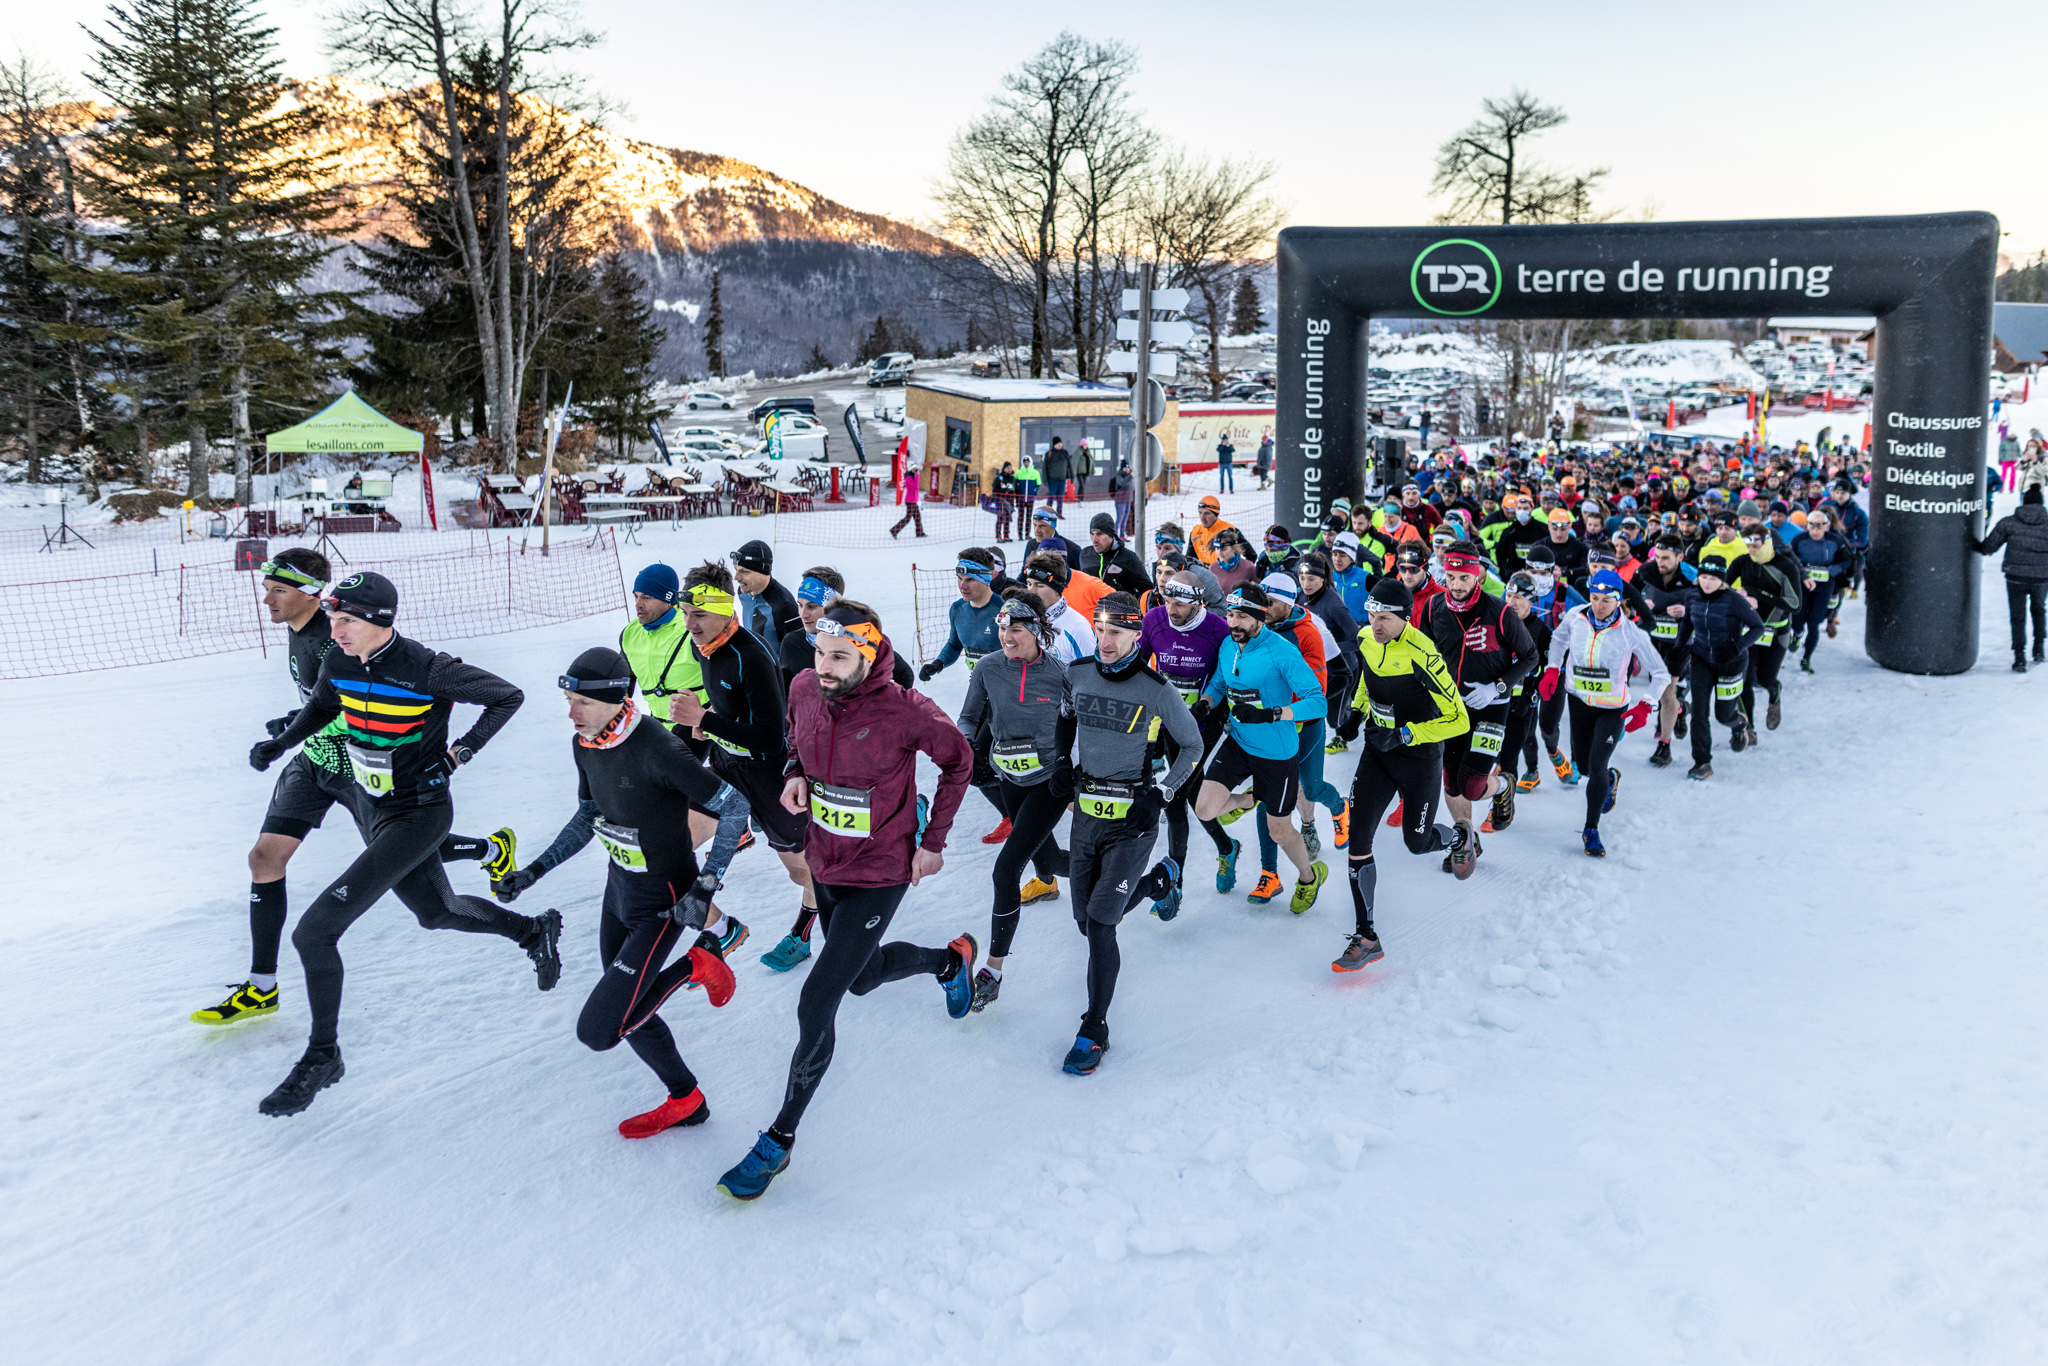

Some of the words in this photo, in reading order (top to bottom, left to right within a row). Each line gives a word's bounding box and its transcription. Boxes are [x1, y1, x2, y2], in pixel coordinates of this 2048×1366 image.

[1422, 265, 1491, 293] TDR
[1517, 263, 1605, 293] terre
[1617, 260, 1664, 292] de
[1677, 258, 1833, 298] running
[1301, 318, 1331, 419] running
[1887, 411, 1982, 430] Chaussures
[306, 439, 385, 450] lesaillons.com
[770, 424, 782, 458] Sprite
[1299, 427, 1323, 459] de
[1887, 439, 1946, 458] Textile
[1886, 466, 1974, 489] Diététique
[1299, 467, 1322, 528] terre
[1885, 494, 1983, 515] Electronique
[1581, 680, 1603, 692] 132
[1480, 736, 1500, 750] 280
[1002, 758, 1030, 771] 245
[844, 795, 865, 803] running
[1094, 801, 1115, 817] 94
[820, 806, 855, 828] 212
[604, 840, 631, 865] 246
